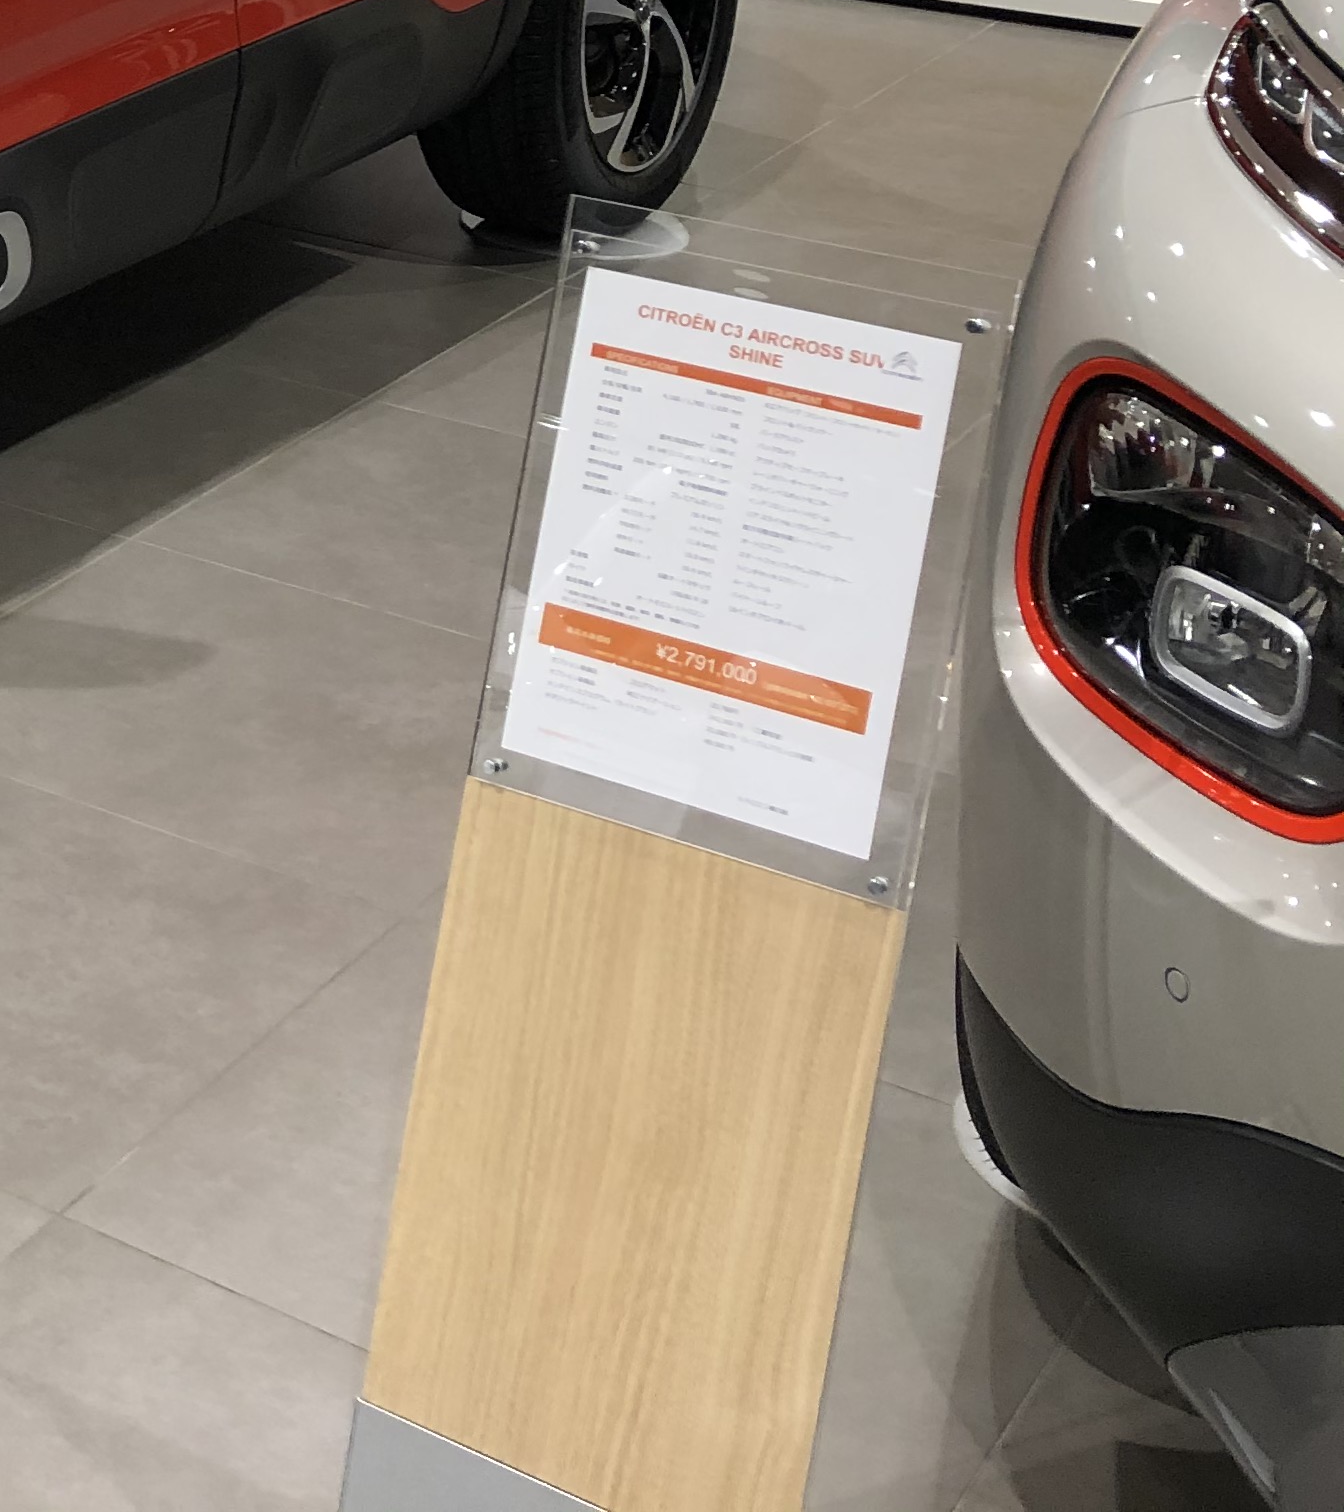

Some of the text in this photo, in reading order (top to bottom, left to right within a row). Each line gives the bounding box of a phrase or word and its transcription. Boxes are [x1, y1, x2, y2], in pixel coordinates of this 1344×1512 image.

[637, 304, 716, 333] CITROËN
[720, 322, 744, 339] C3
[747, 328, 844, 361] AIRCROSS
[728, 345, 784, 369] SHINE
[655, 642, 758, 686] ¥2,791,000
